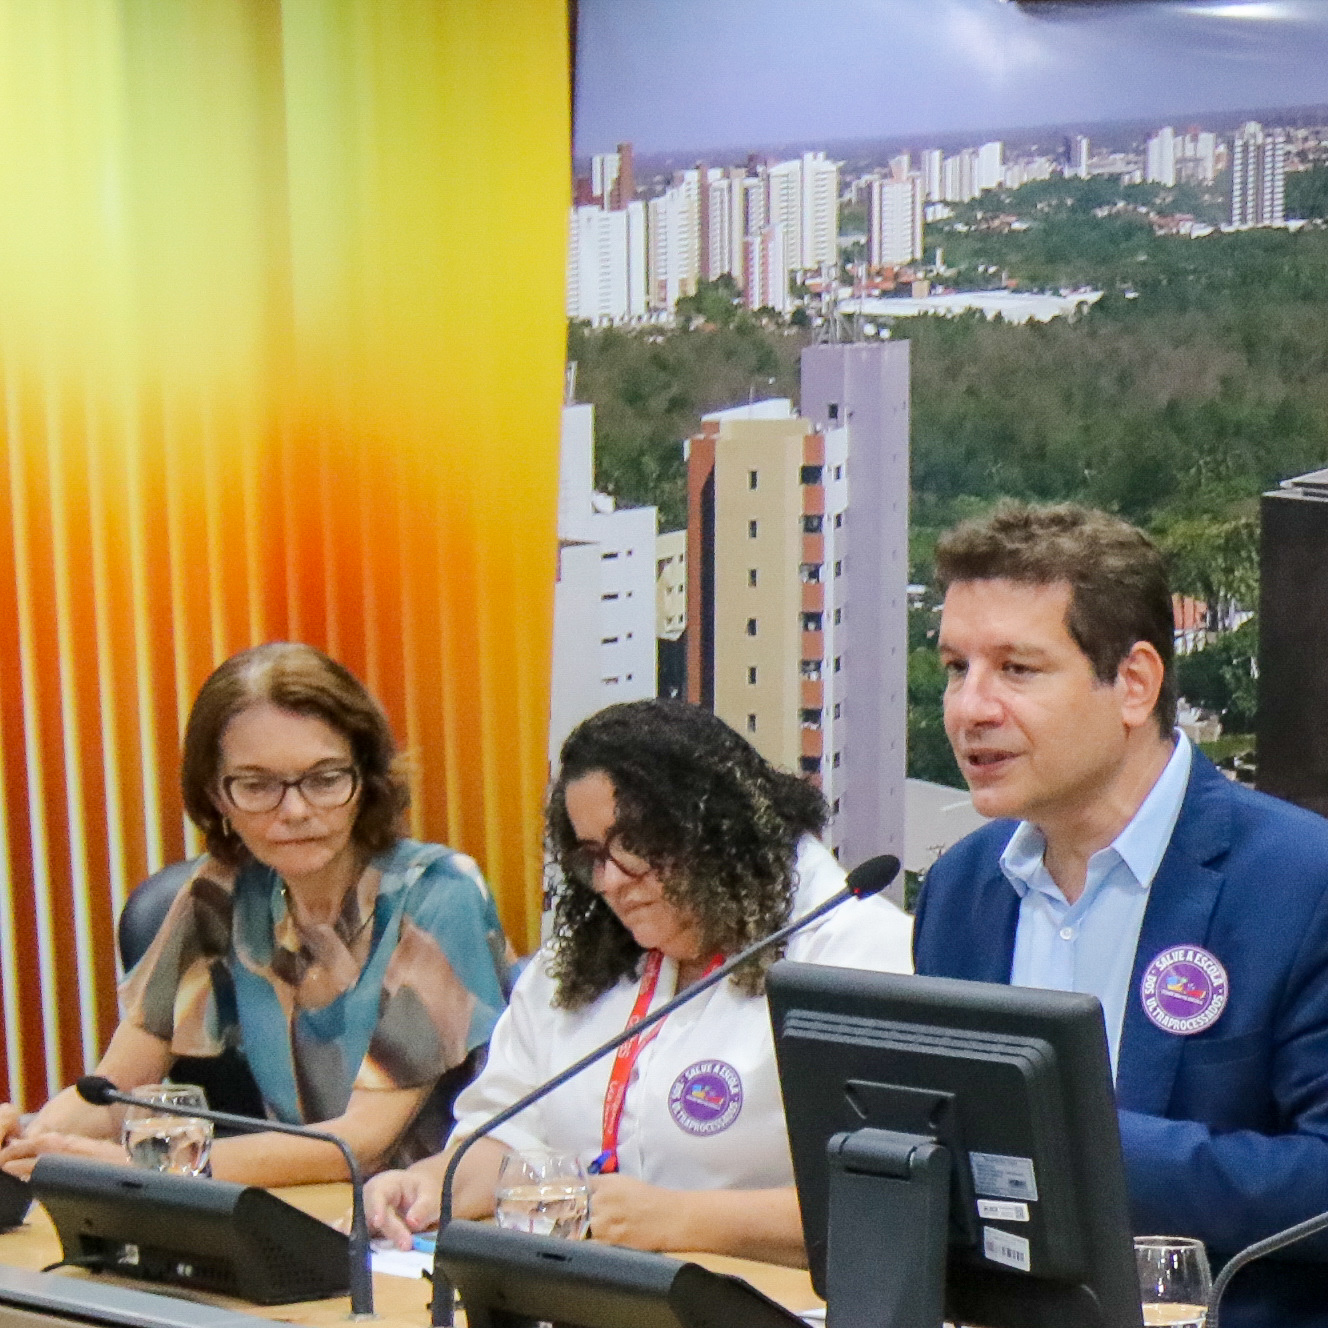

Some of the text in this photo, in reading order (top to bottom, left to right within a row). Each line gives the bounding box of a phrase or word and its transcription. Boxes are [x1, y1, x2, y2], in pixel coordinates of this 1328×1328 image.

[1156, 950, 1224, 987] SALVE A ESCOLA
[1146, 994, 1223, 1030] ULTRAPROCESSADOS
